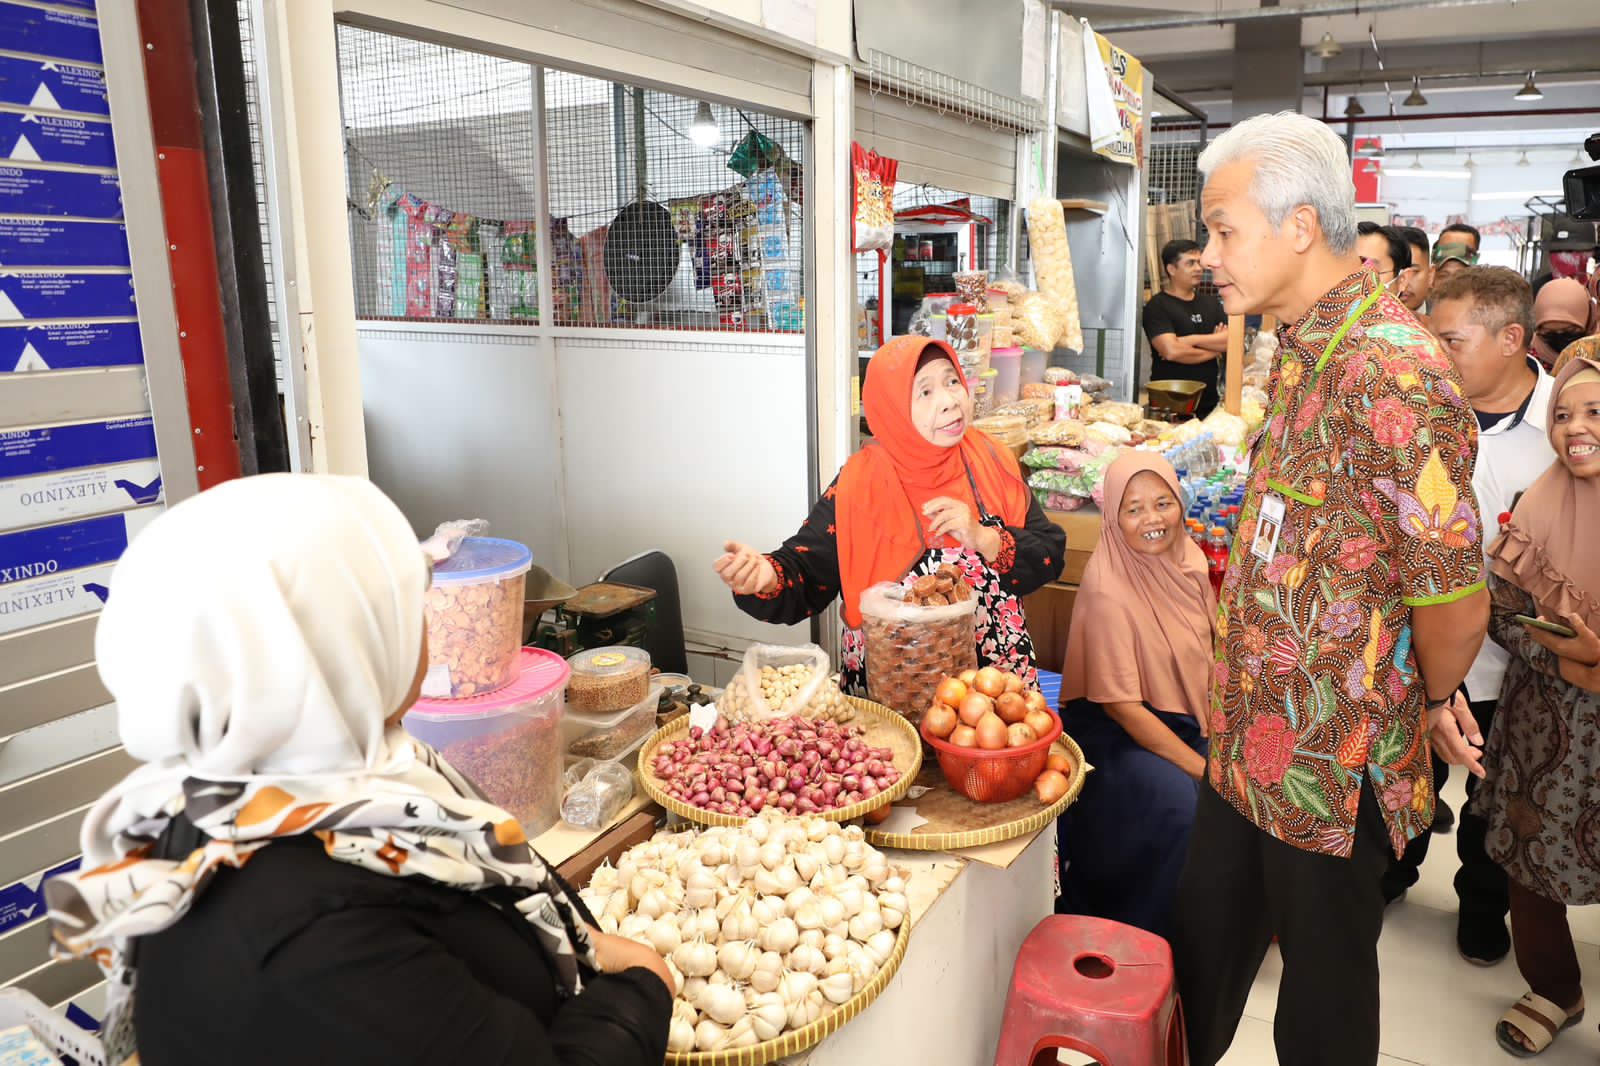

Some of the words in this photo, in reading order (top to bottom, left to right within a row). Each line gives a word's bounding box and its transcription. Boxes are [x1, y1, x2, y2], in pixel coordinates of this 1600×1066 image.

[40, 117, 85, 129] ALEXINDO
[0, 429, 30, 440] XINDO
[20, 480, 108, 507] ALEXINDO
[0, 559, 58, 583] XINDO
